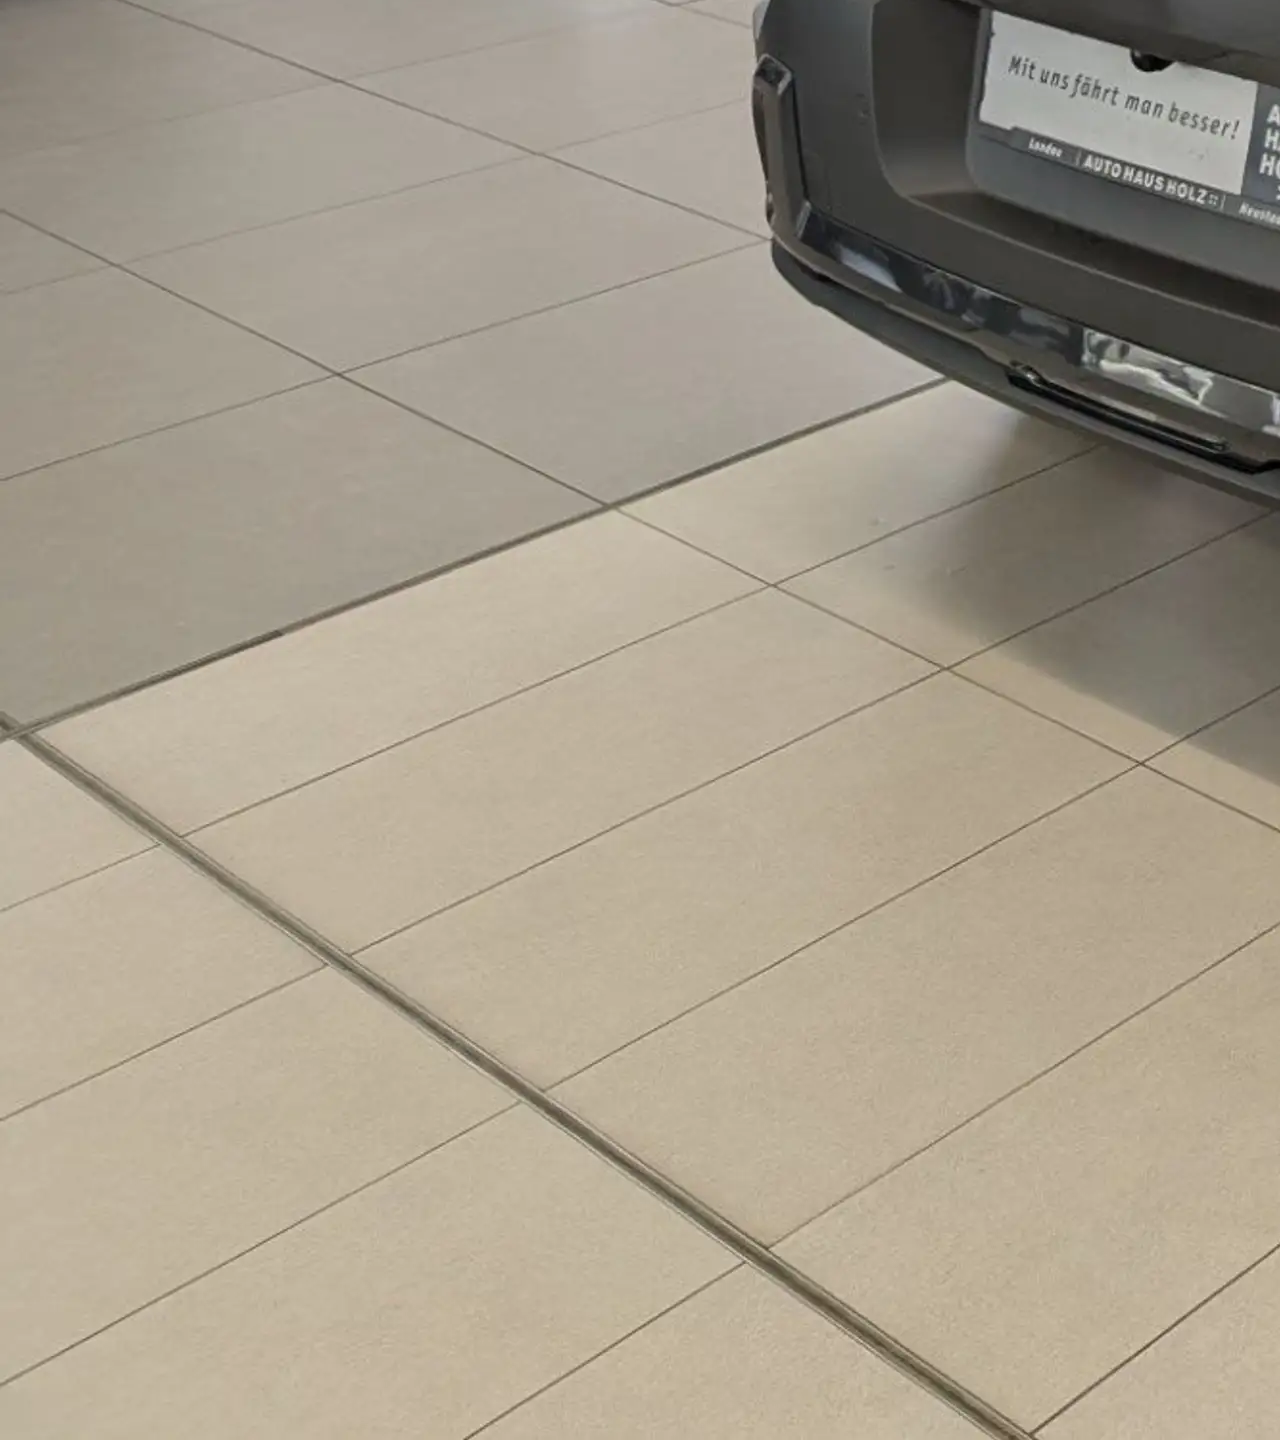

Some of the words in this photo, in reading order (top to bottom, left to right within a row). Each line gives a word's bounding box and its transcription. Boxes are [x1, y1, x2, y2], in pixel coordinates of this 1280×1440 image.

[1008, 55, 1035, 80] Mit
[1040, 67, 1069, 91] uns
[1069, 73, 1120, 107] fährt
[1124, 93, 1164, 119] man
[1168, 101, 1240, 140] besser!
[1083, 154, 1123, 178] AUTO
[1123, 164, 1165, 192] HAUS
[1166, 179, 1206, 205] HOLZ
